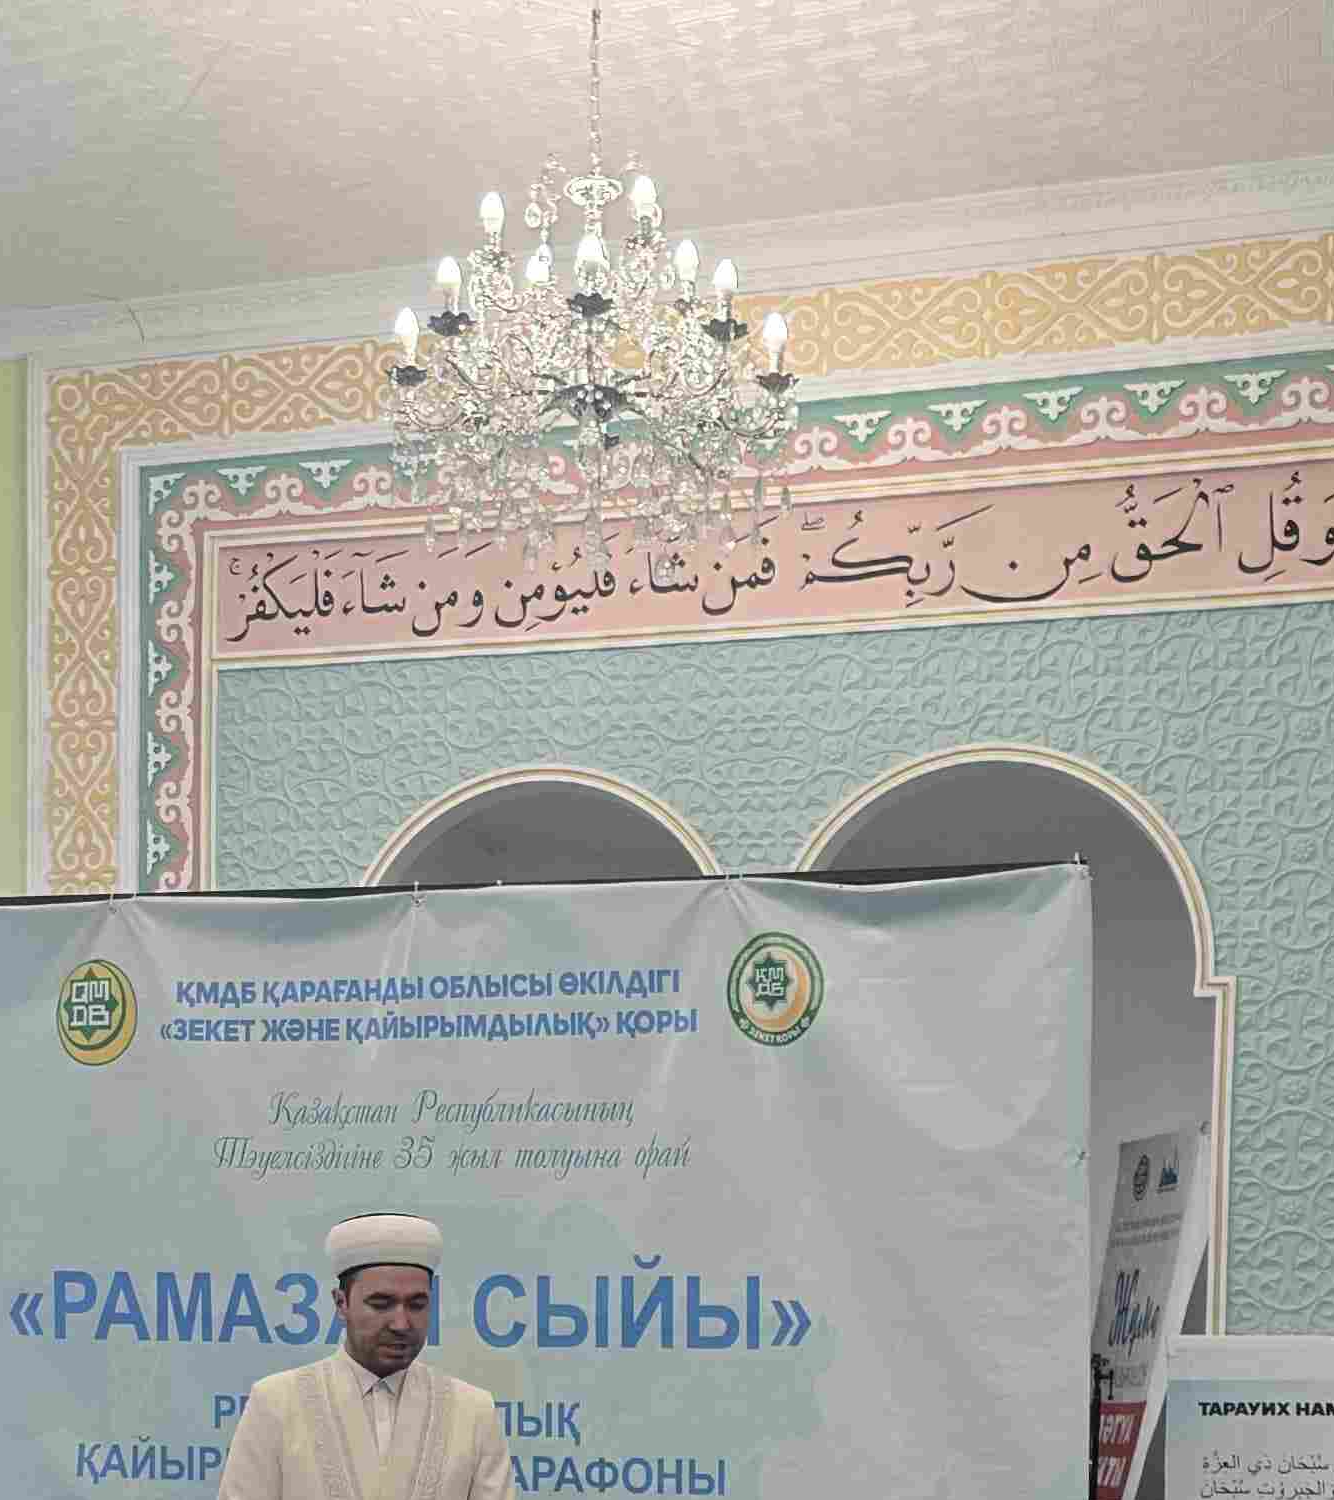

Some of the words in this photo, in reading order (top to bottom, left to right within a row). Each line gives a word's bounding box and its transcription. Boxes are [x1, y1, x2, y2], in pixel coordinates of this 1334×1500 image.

[175, 981, 257, 1008] ҚМДБ
[262, 975, 424, 1008] ҚАРАҒАНДЫ
[428, 973, 553, 999] ОБЛЫСЫ
[559, 968, 682, 999] ӨКІЛДІГІ
[159, 1018, 256, 1042] «ЗЕКЕТ
[260, 1017, 341, 1042] ЖӘНЕ
[345, 1010, 610, 1044] ҚАЙЫРЫМДЫЛЫҚ»
[615, 1008, 699, 1039] ҚОРЫ
[267, 1088, 401, 1131] Қазақстан
[393, 1135, 436, 1170] 35
[449, 1143, 501, 1177] жыл
[514, 1145, 623, 1181] толуына
[634, 1128, 692, 1180] орай
[9, 1268, 440, 1346] «РАМАЗ
[471, 1255, 814, 1350] СЫЙЫ»
[1198, 1401, 1292, 1416] ТАРАУИХ
[75, 1436, 231, 1485] ҚАЙЫР
[510, 1455, 727, 1498] АРАФОНЫ
